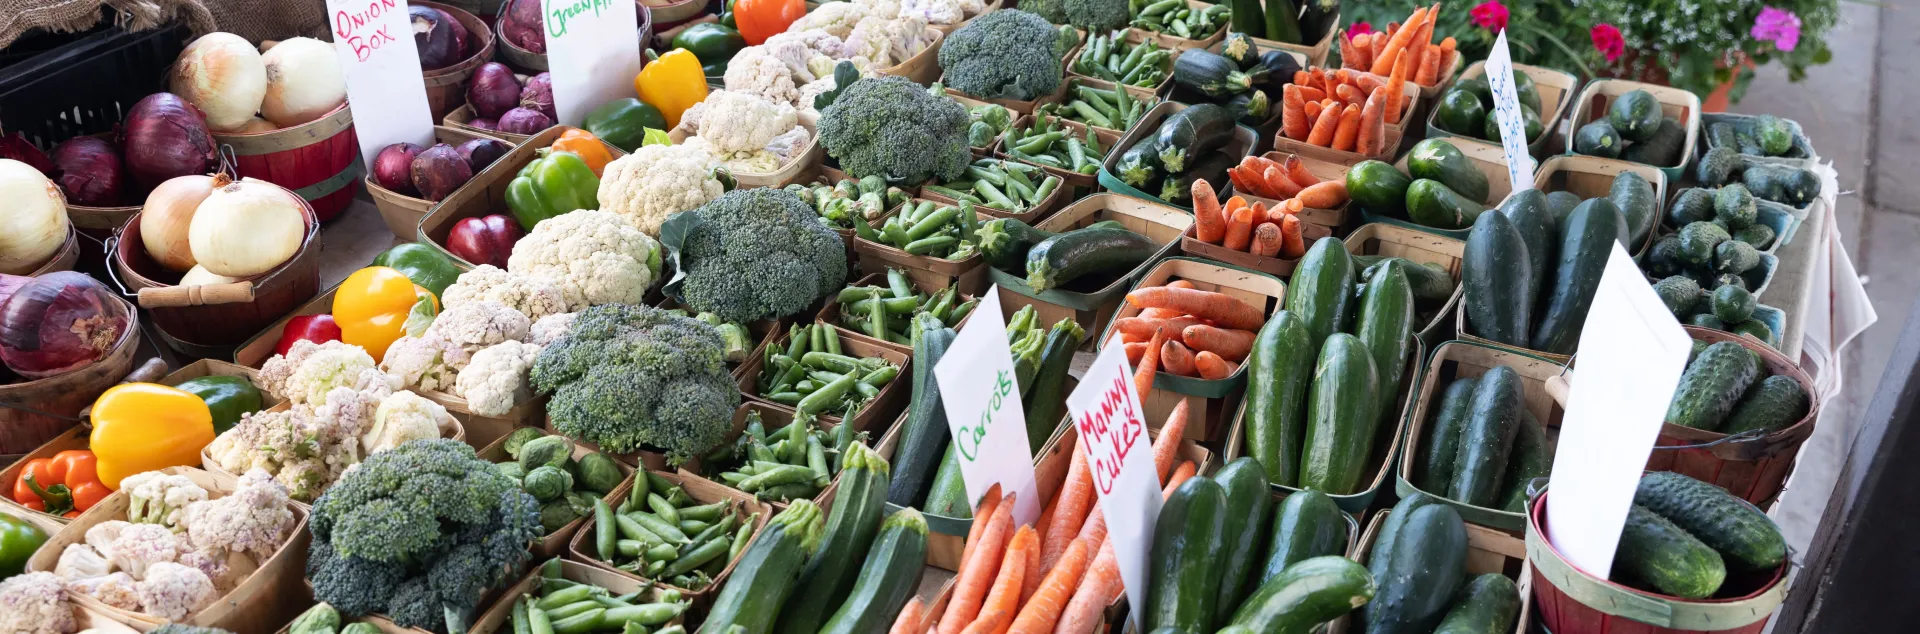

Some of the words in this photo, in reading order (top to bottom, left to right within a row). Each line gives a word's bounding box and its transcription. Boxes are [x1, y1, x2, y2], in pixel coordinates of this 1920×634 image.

[336, 0, 396, 39] ONION
[347, 24, 396, 62] BOX
[958, 369, 1013, 462] Carrots
